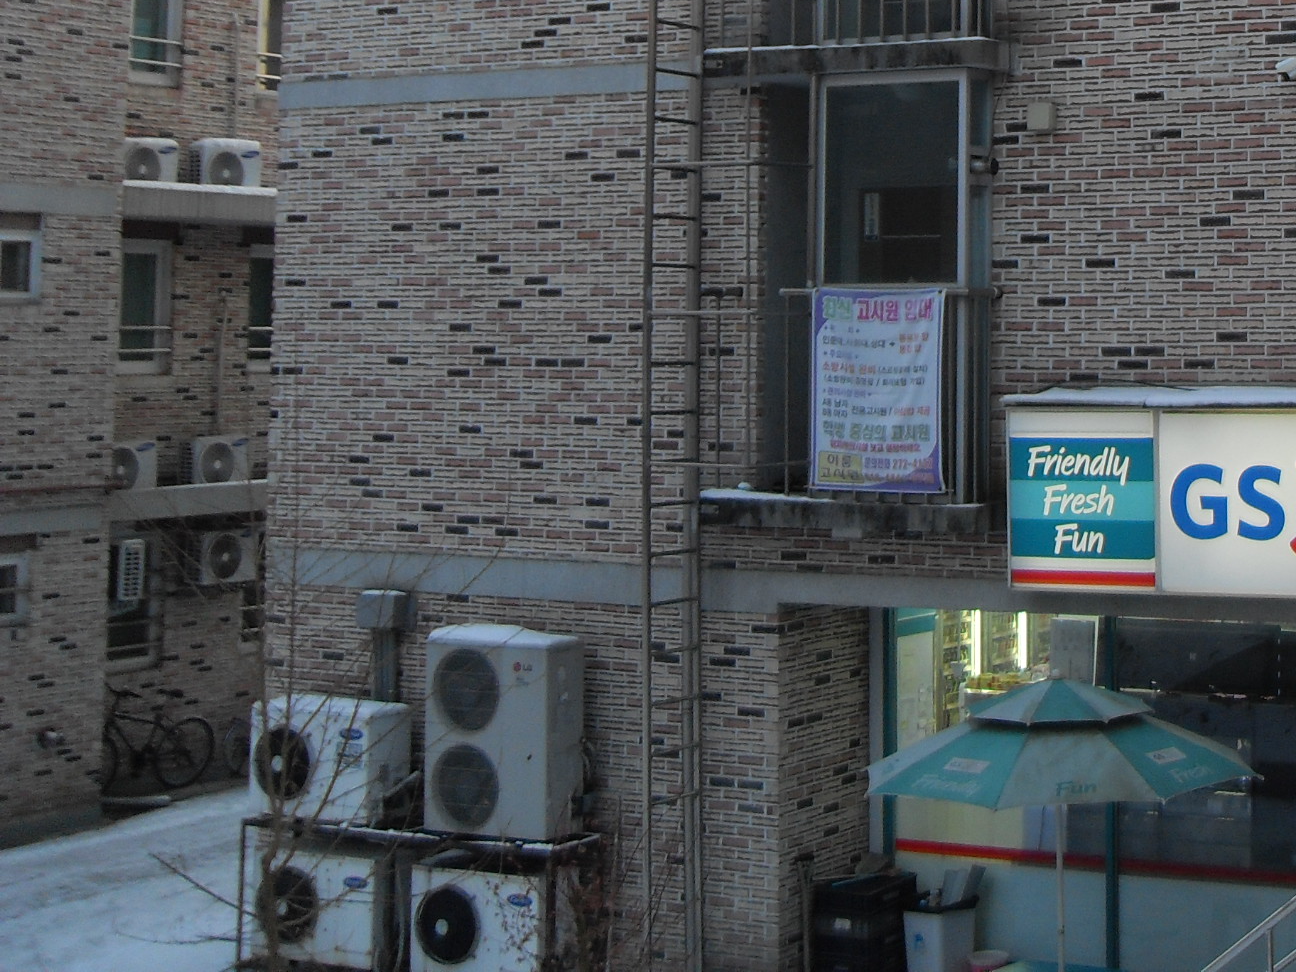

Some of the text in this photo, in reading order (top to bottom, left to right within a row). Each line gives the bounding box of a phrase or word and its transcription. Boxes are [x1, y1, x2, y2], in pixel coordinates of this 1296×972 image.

[855, 296, 900, 323] 고시원
[890, 423, 931, 442] 고시원
[1027, 445, 1130, 483] Friendly
[1043, 484, 1115, 517] Fresh
[1054, 524, 1105, 555] Fun
[1056, 780, 1098, 797] Fun
